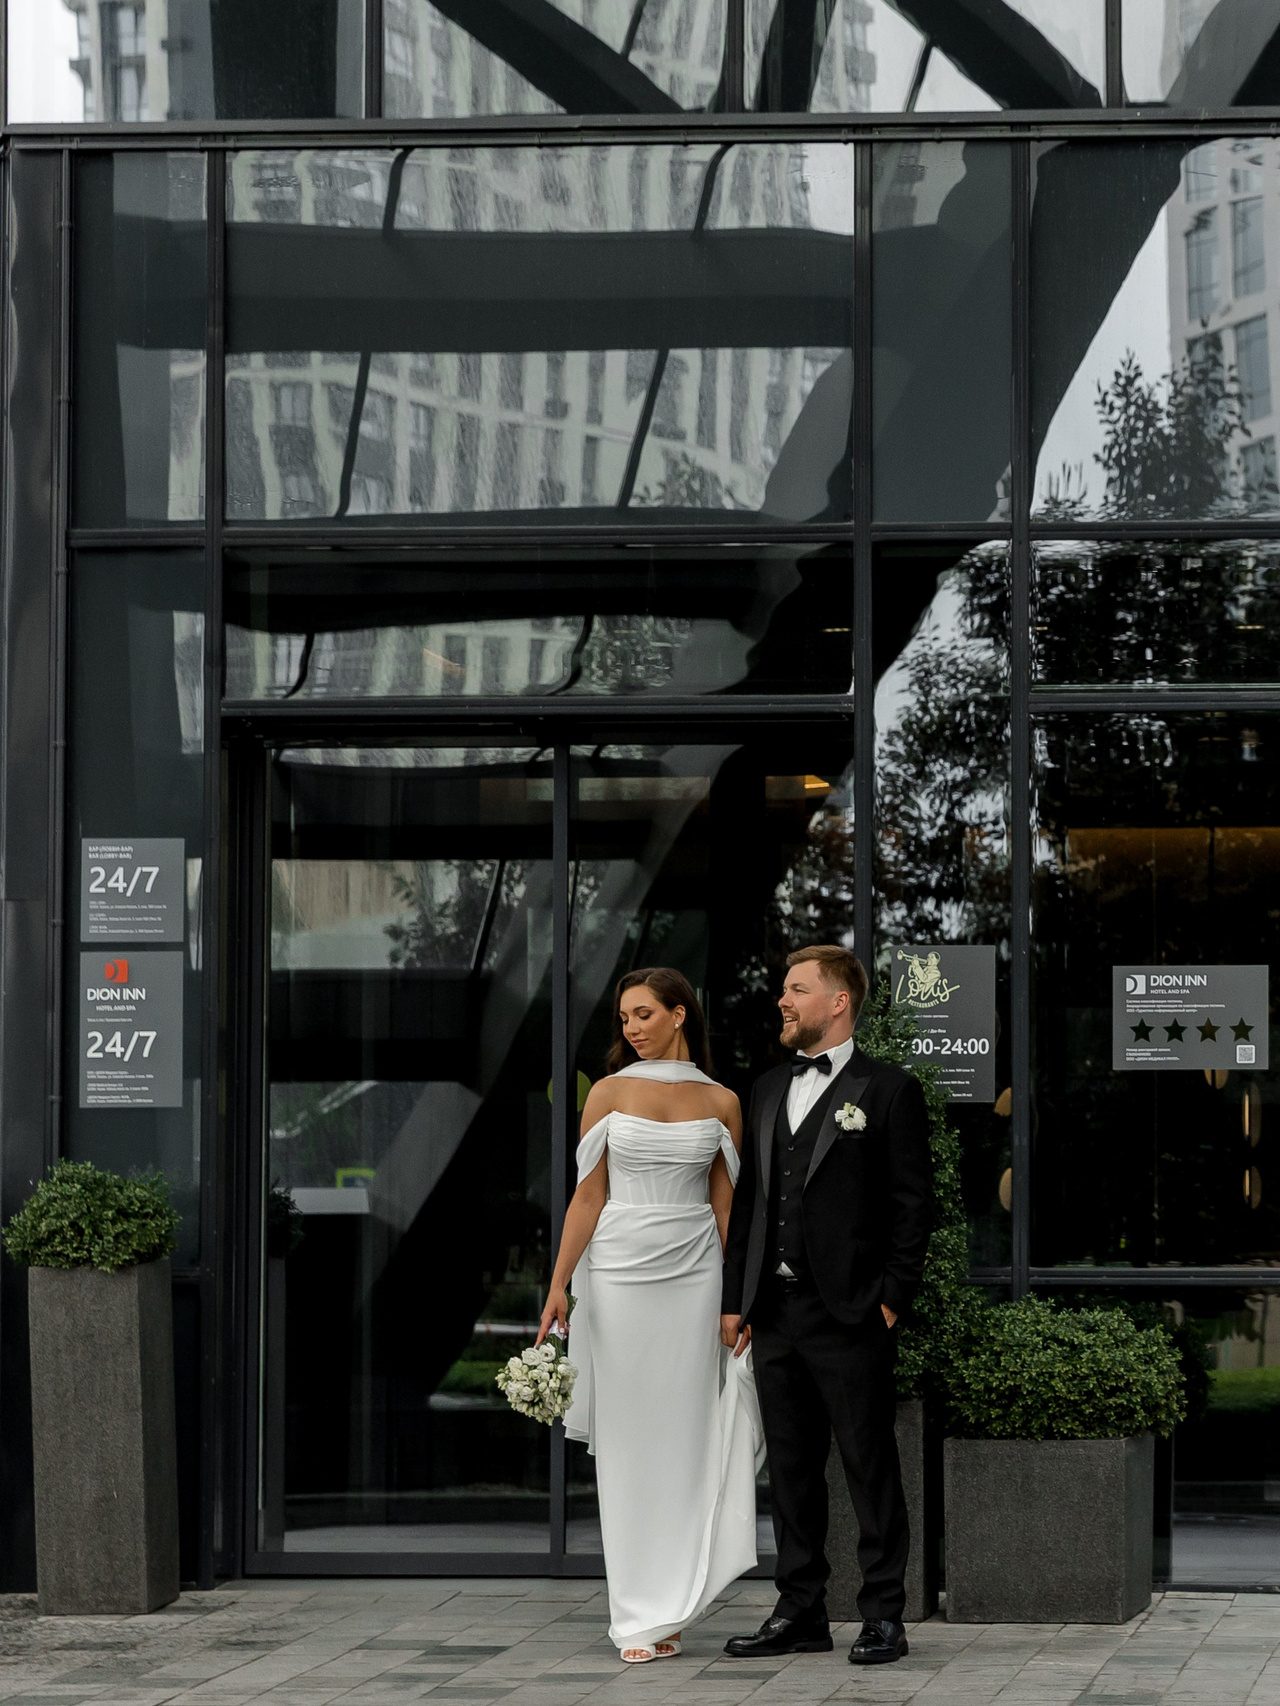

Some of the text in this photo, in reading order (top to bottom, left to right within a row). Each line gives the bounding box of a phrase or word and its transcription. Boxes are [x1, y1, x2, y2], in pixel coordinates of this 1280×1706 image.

[89, 866, 159, 897] 24/7
[87, 988, 146, 1000] DION INN
[895, 975, 960, 1003] Louis
[1150, 975, 1207, 987] DION INN
[87, 1031, 157, 1062] 24/7
